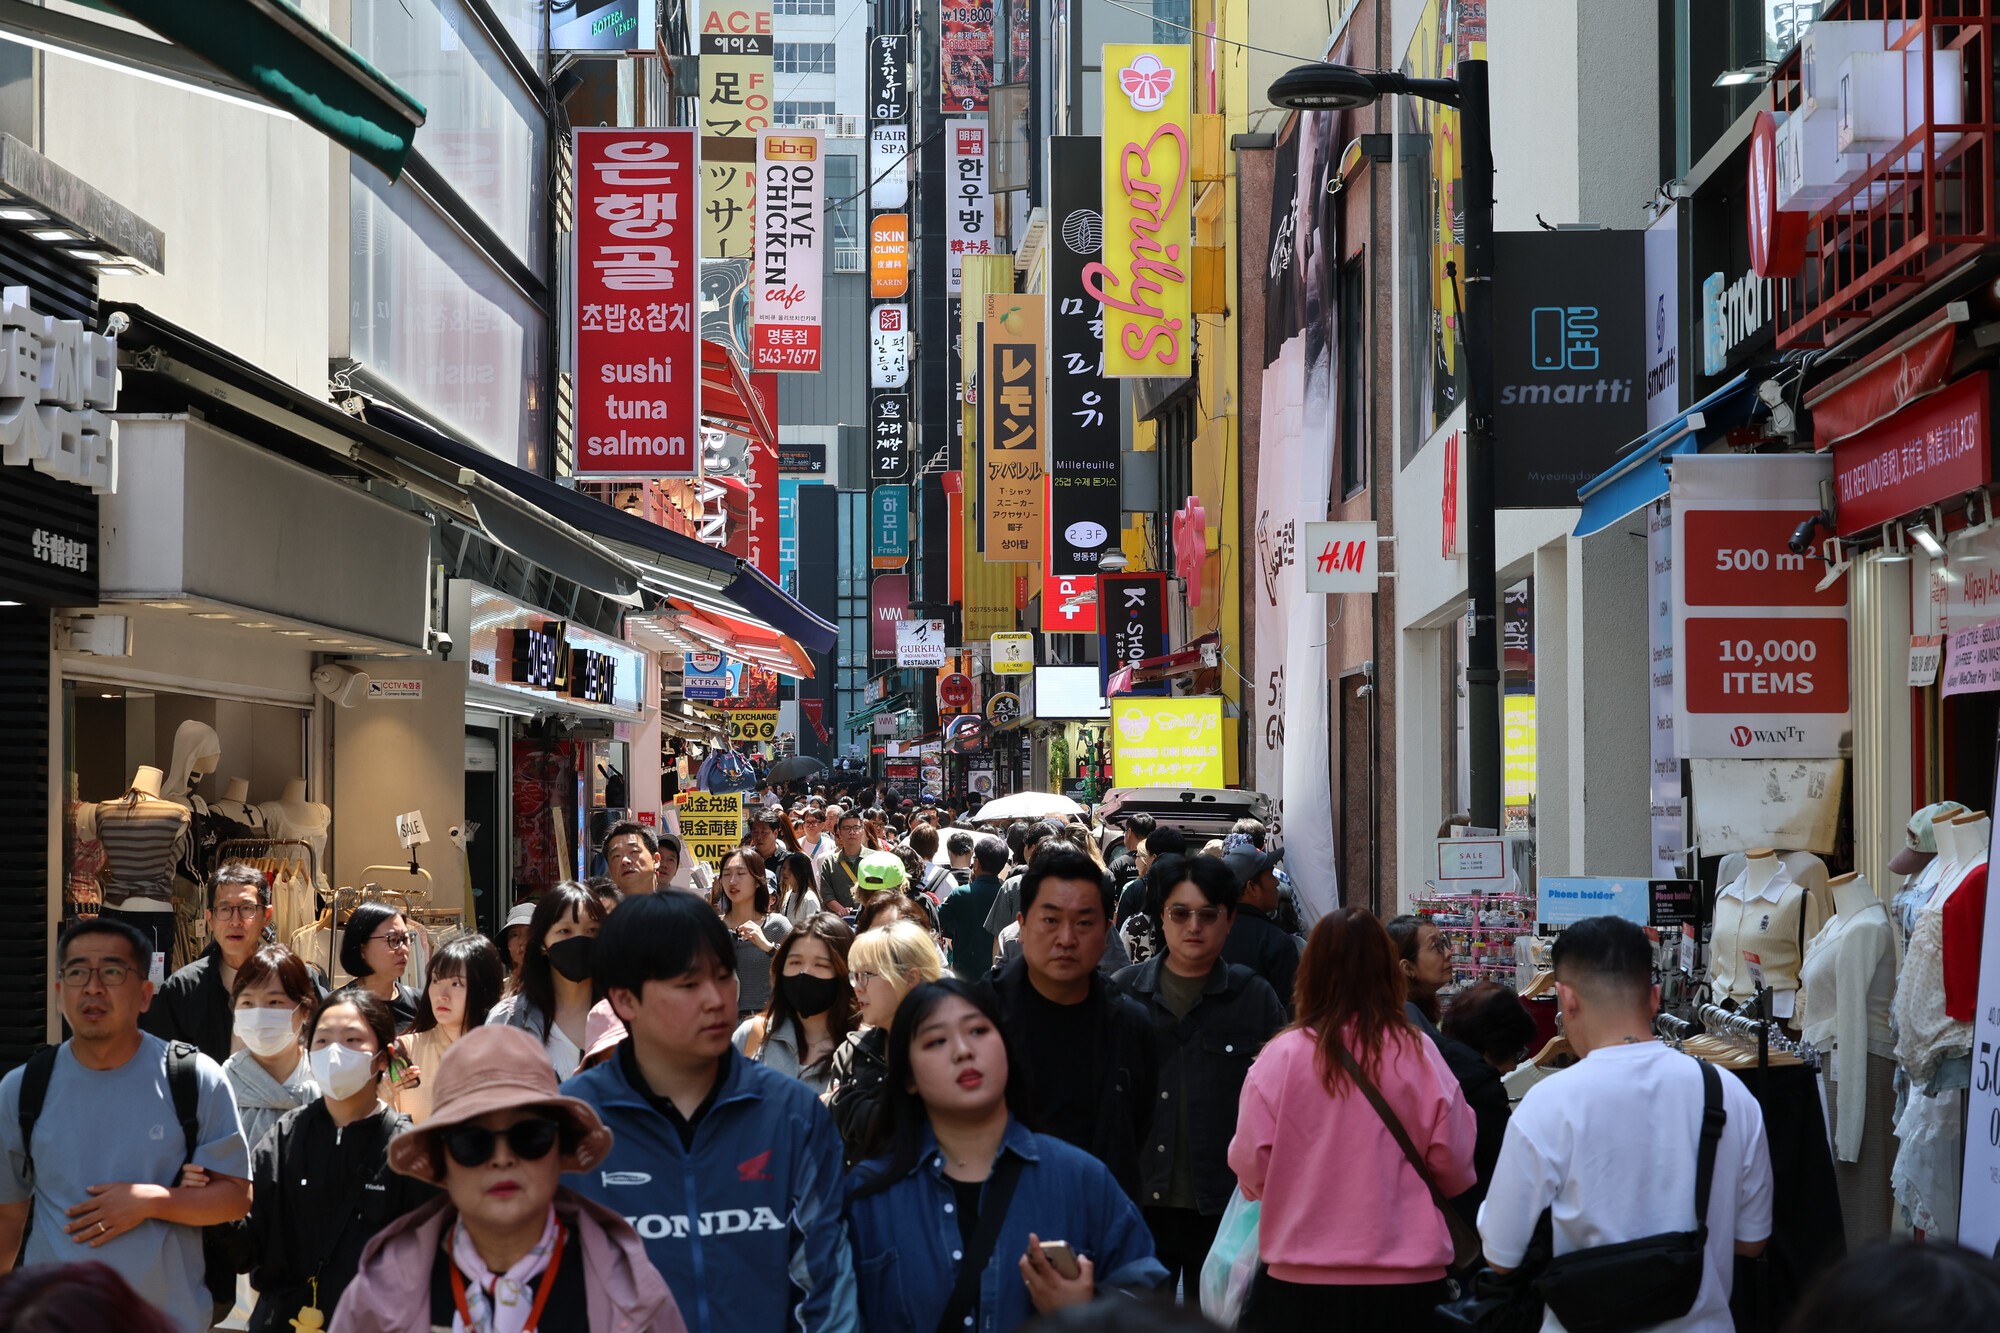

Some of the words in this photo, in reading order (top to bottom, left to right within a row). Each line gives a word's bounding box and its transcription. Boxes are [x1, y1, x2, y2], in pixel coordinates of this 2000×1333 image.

[592, 10, 624, 36] BOTTEGA
[614, 17, 637, 38] VENETA
[703, 11, 771, 34] ACE
[714, 37, 760, 54] 에이스
[876, 104, 901, 118] 6F
[962, 101, 972, 109] 4F
[873, 131, 907, 141] HAIR
[881, 144, 907, 154] SPA
[958, 158, 985, 234] 한우방
[790, 165, 816, 249] OLIVE
[592, 141, 680, 291] 은행골
[764, 164, 789, 286] CHICKEN
[873, 231, 905, 242] SKIN
[1081, 122, 1189, 366] Emily's
[873, 245, 905, 254] CLINIC
[876, 279, 903, 287] KARIN
[764, 284, 807, 311] cafe
[581, 302, 691, 334] 초밥&참치
[767, 329, 809, 346] 명동점
[758, 348, 818, 366] 543-7677
[600, 357, 673, 383] sushi
[885, 374, 898, 384] 3F
[1000, 348, 1035, 449] レモン
[1500, 378, 1633, 406] smartti
[605, 394, 668, 420] tuna
[876, 422, 903, 436] 수라
[587, 429, 686, 456] salmon
[811, 461, 822, 471] 3F
[881, 457, 899, 470] 2F
[988, 461, 1043, 481] アパレル
[1056, 461, 1115, 470] Millefeuille
[1074, 477, 1091, 487] 수제
[1093, 477, 1118, 487] 돈가스
[883, 497, 898, 546] 하모니
[877, 546, 903, 555] Fresh
[1001, 540, 1029, 549] 상아탑
[1072, 552, 1098, 561] 명동점
[1316, 540, 1366, 574] H&M
[1716, 549, 1769, 570] 500
[1123, 587, 1147, 608] K
[1963, 570, 1988, 608] Alipay
[879, 607, 903, 620] WM
[932, 622, 942, 630] 5F
[900, 644, 942, 653] GURKHA
[1718, 639, 1817, 667] 10,000
[382, 682, 402, 690] CCTV
[1722, 672, 1815, 694] ITEMS
[735, 713, 777, 721] EXCHANGE
[1119, 747, 1159, 758] PRESS
[1161, 747, 1179, 757] ON
[1182, 746, 1218, 756] NAILS
[400, 820, 421, 838] SALE
[1459, 852, 1483, 860] SALE
[1549, 889, 1579, 899] Phone
[1580, 889, 1615, 900] holder
